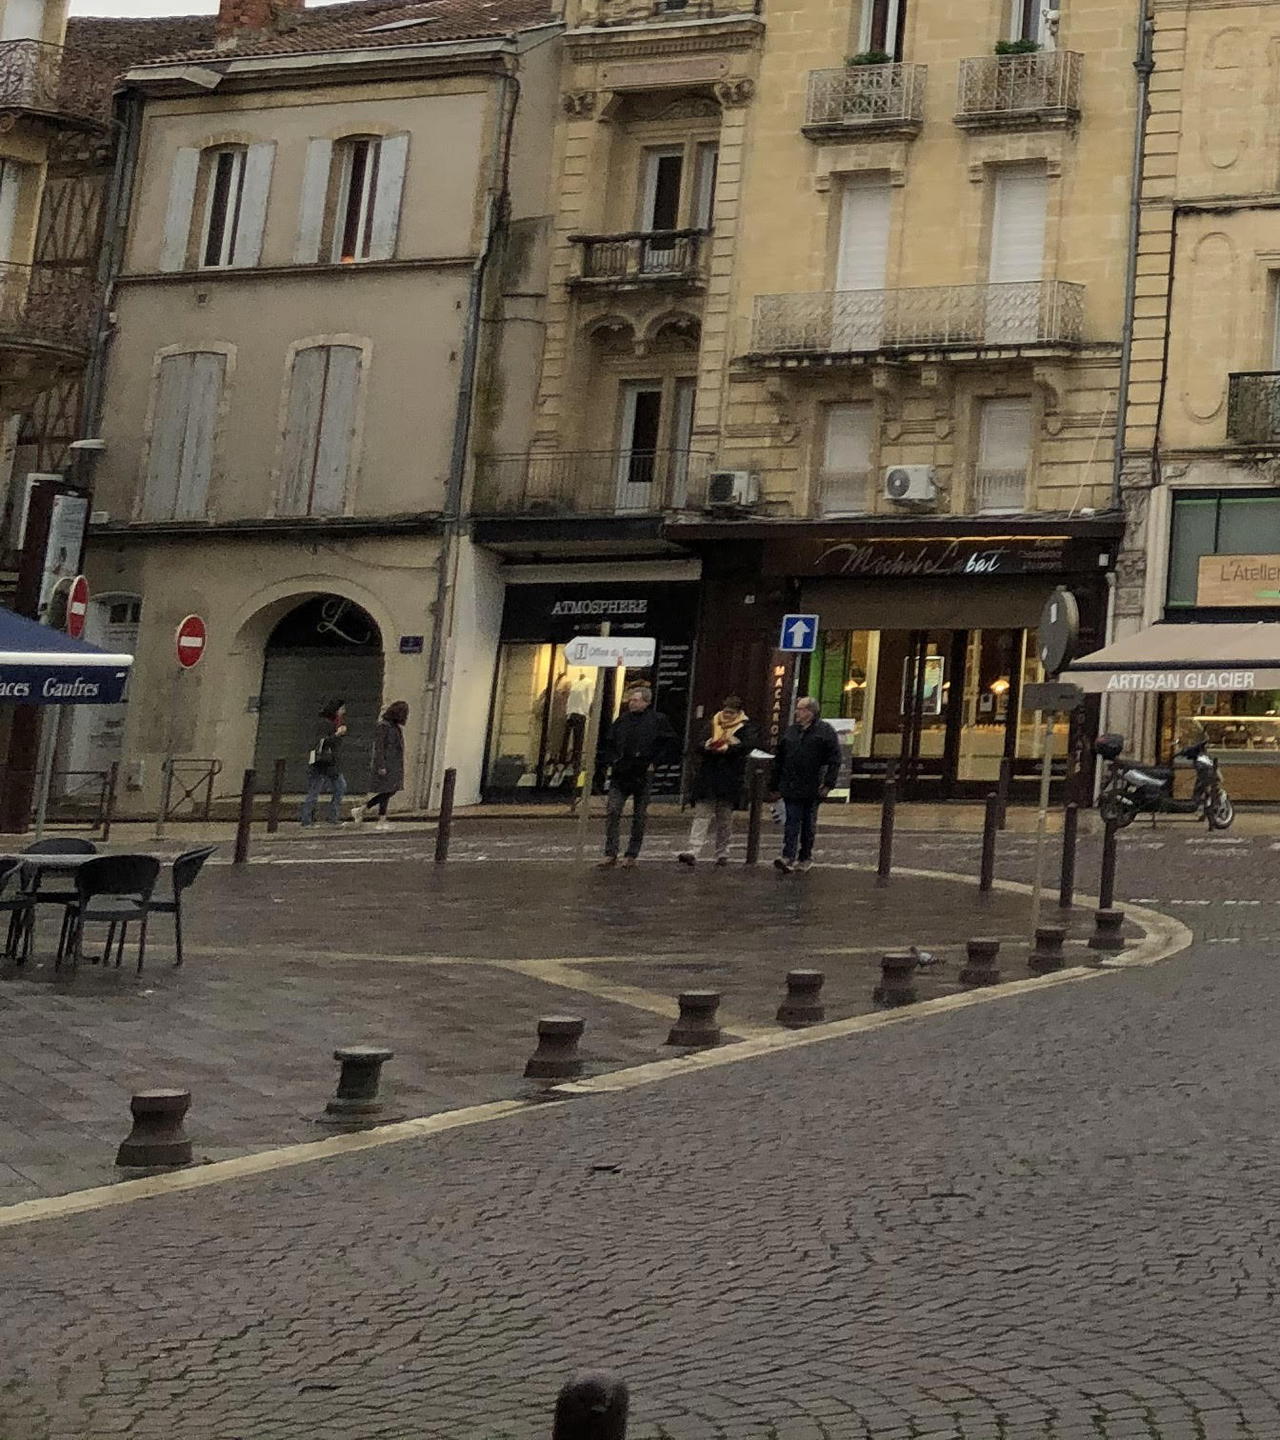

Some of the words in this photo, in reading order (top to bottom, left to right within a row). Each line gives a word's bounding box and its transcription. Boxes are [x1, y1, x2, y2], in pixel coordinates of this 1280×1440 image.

[551, 600, 648, 615] ATMOSPHERE
[0, 680, 31, 697] aces
[42, 677, 100, 697] Gaufres
[1107, 673, 1180, 690] ARTISAN
[1184, 672, 1254, 689] GLACIER
